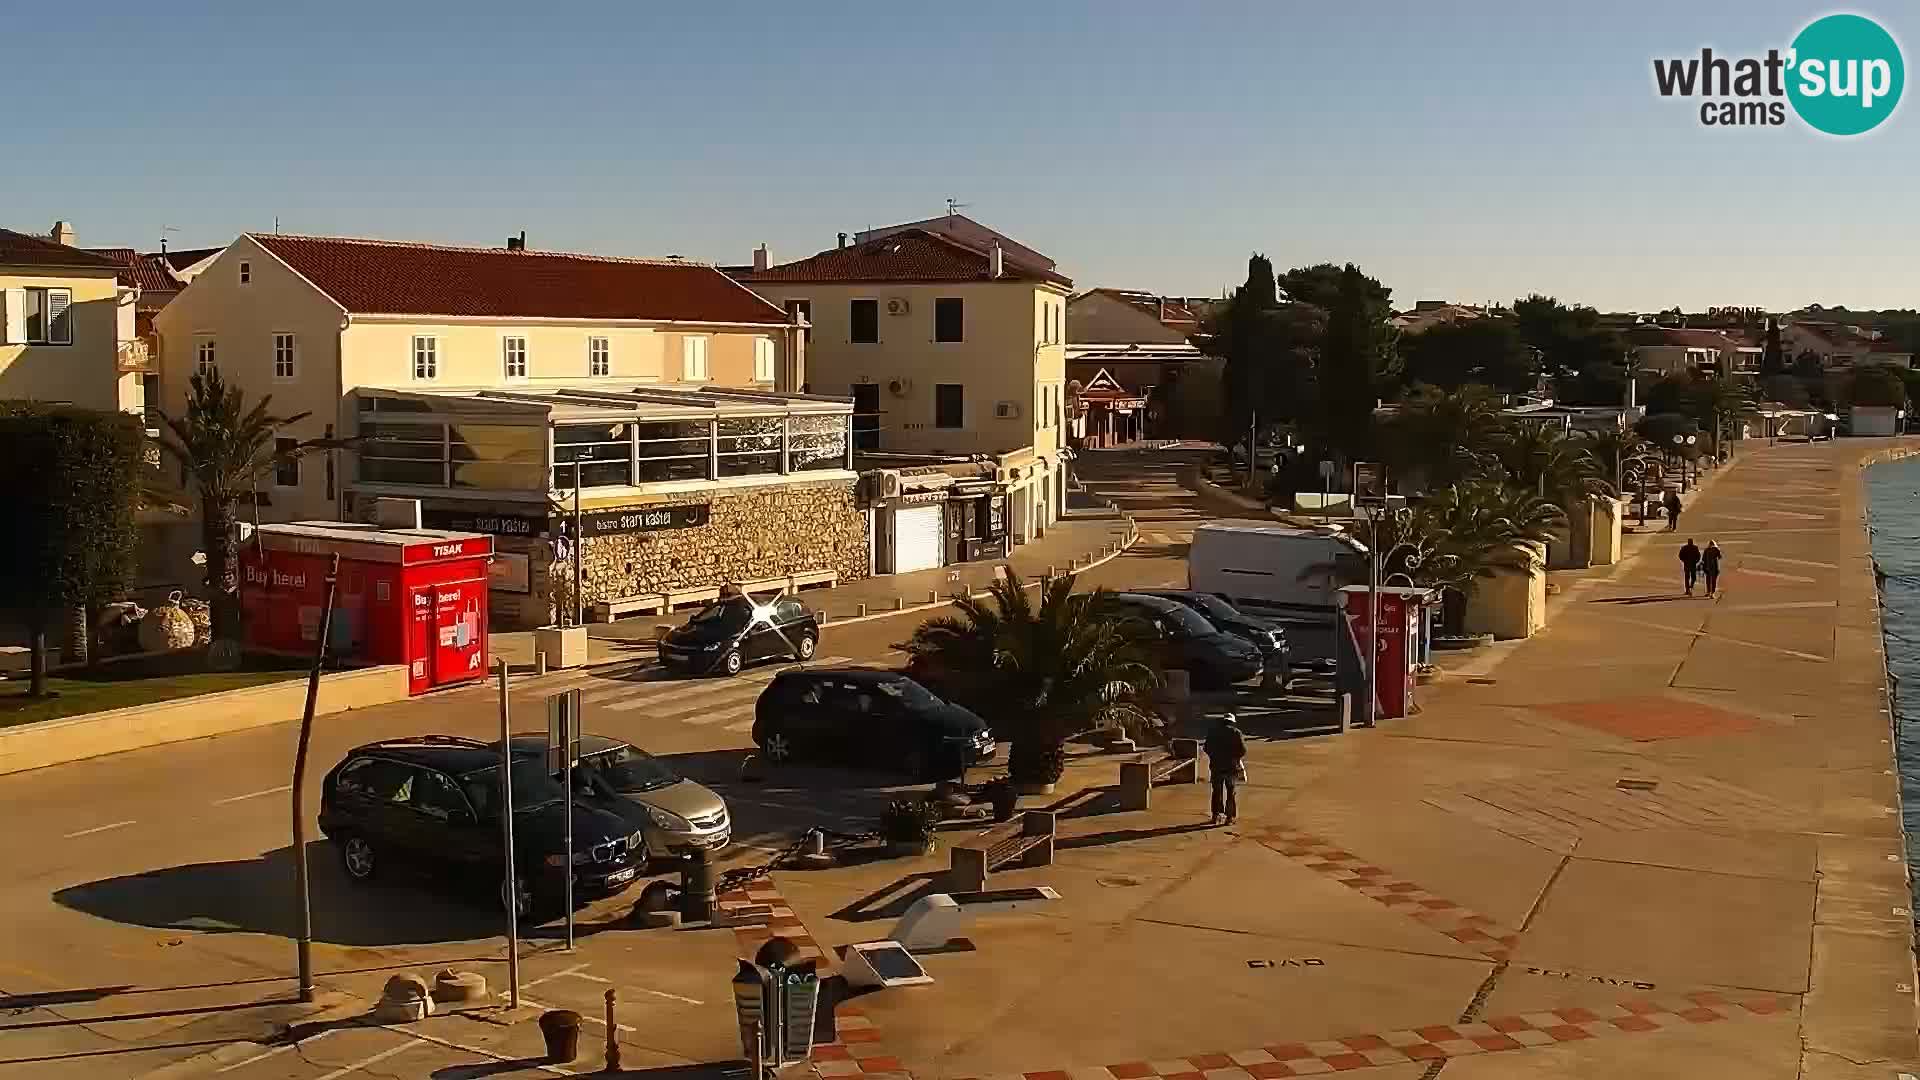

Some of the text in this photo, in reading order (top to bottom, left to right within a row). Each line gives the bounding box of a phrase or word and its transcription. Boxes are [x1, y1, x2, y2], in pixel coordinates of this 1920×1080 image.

[596, 519, 617, 530] bistro
[434, 543, 463, 556] TISAK
[247, 567, 268, 587] Buy
